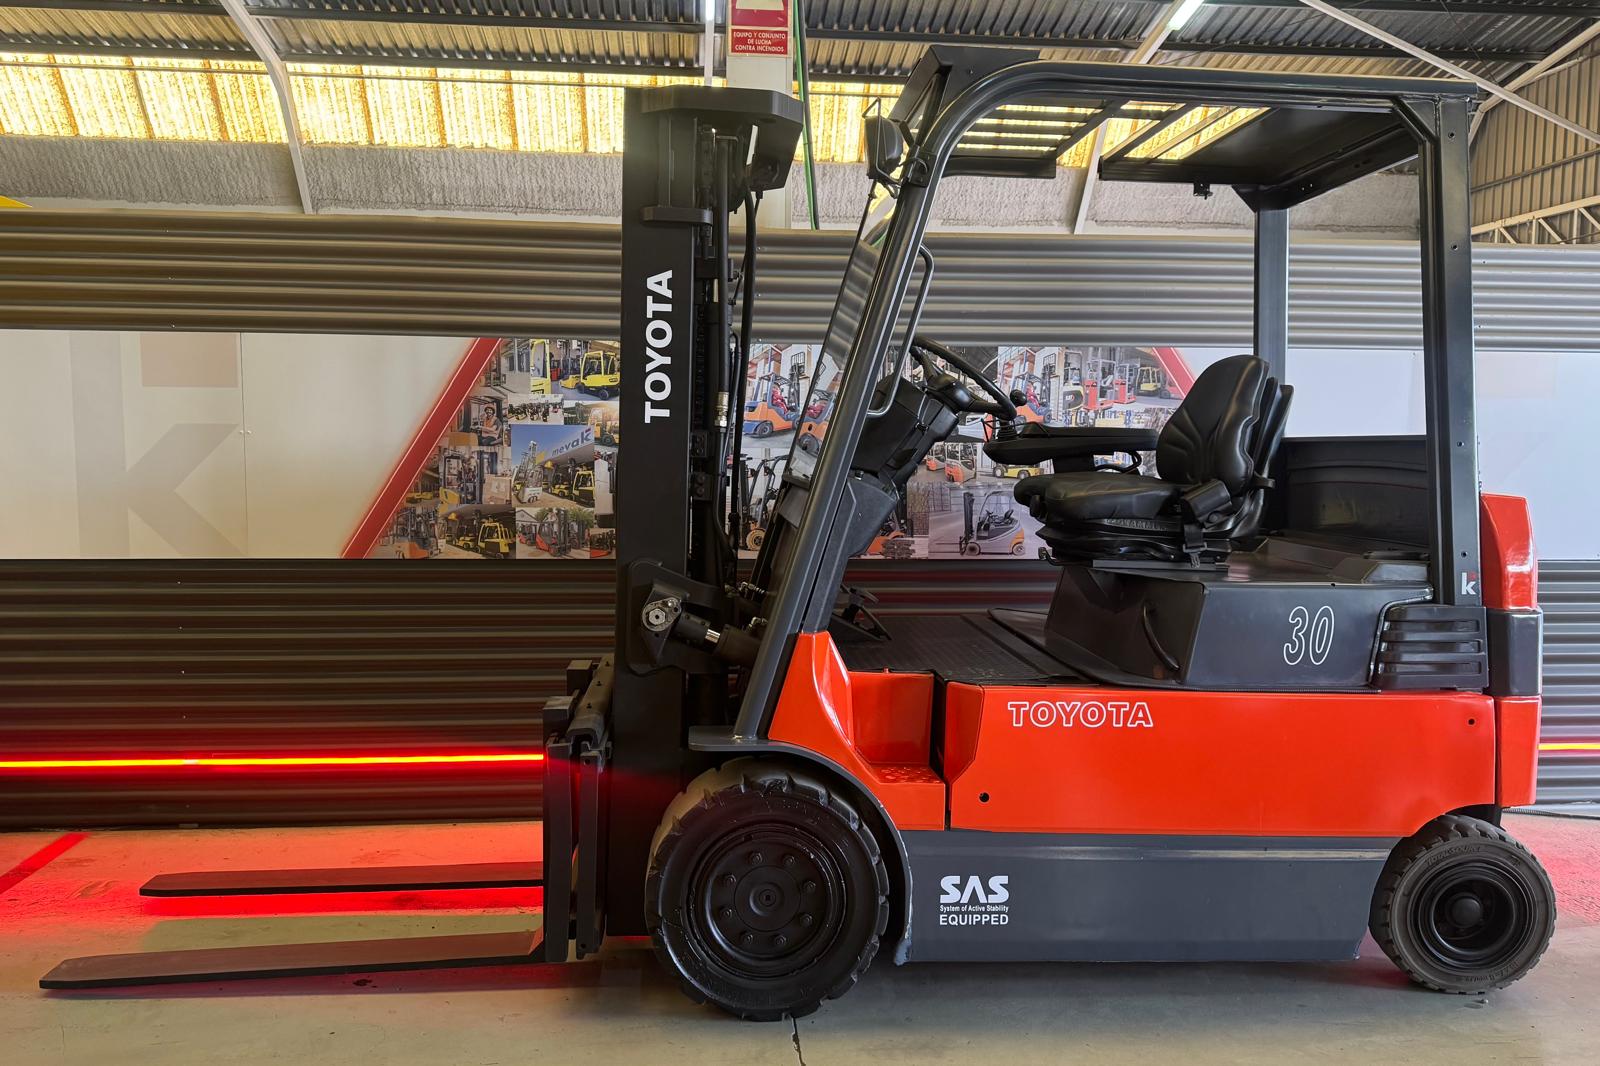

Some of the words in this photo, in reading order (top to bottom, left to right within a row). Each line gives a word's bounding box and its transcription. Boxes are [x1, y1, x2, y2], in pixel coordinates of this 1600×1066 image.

[644, 269, 673, 424] TOYOTA
[1283, 605, 1335, 666] 30
[1008, 701, 1153, 728] TOYOTA
[940, 875, 1009, 903] SAS
[940, 905, 960, 913] System
[986, 905, 1009, 913] Stability
[940, 914, 1009, 926] EQUIPPED
